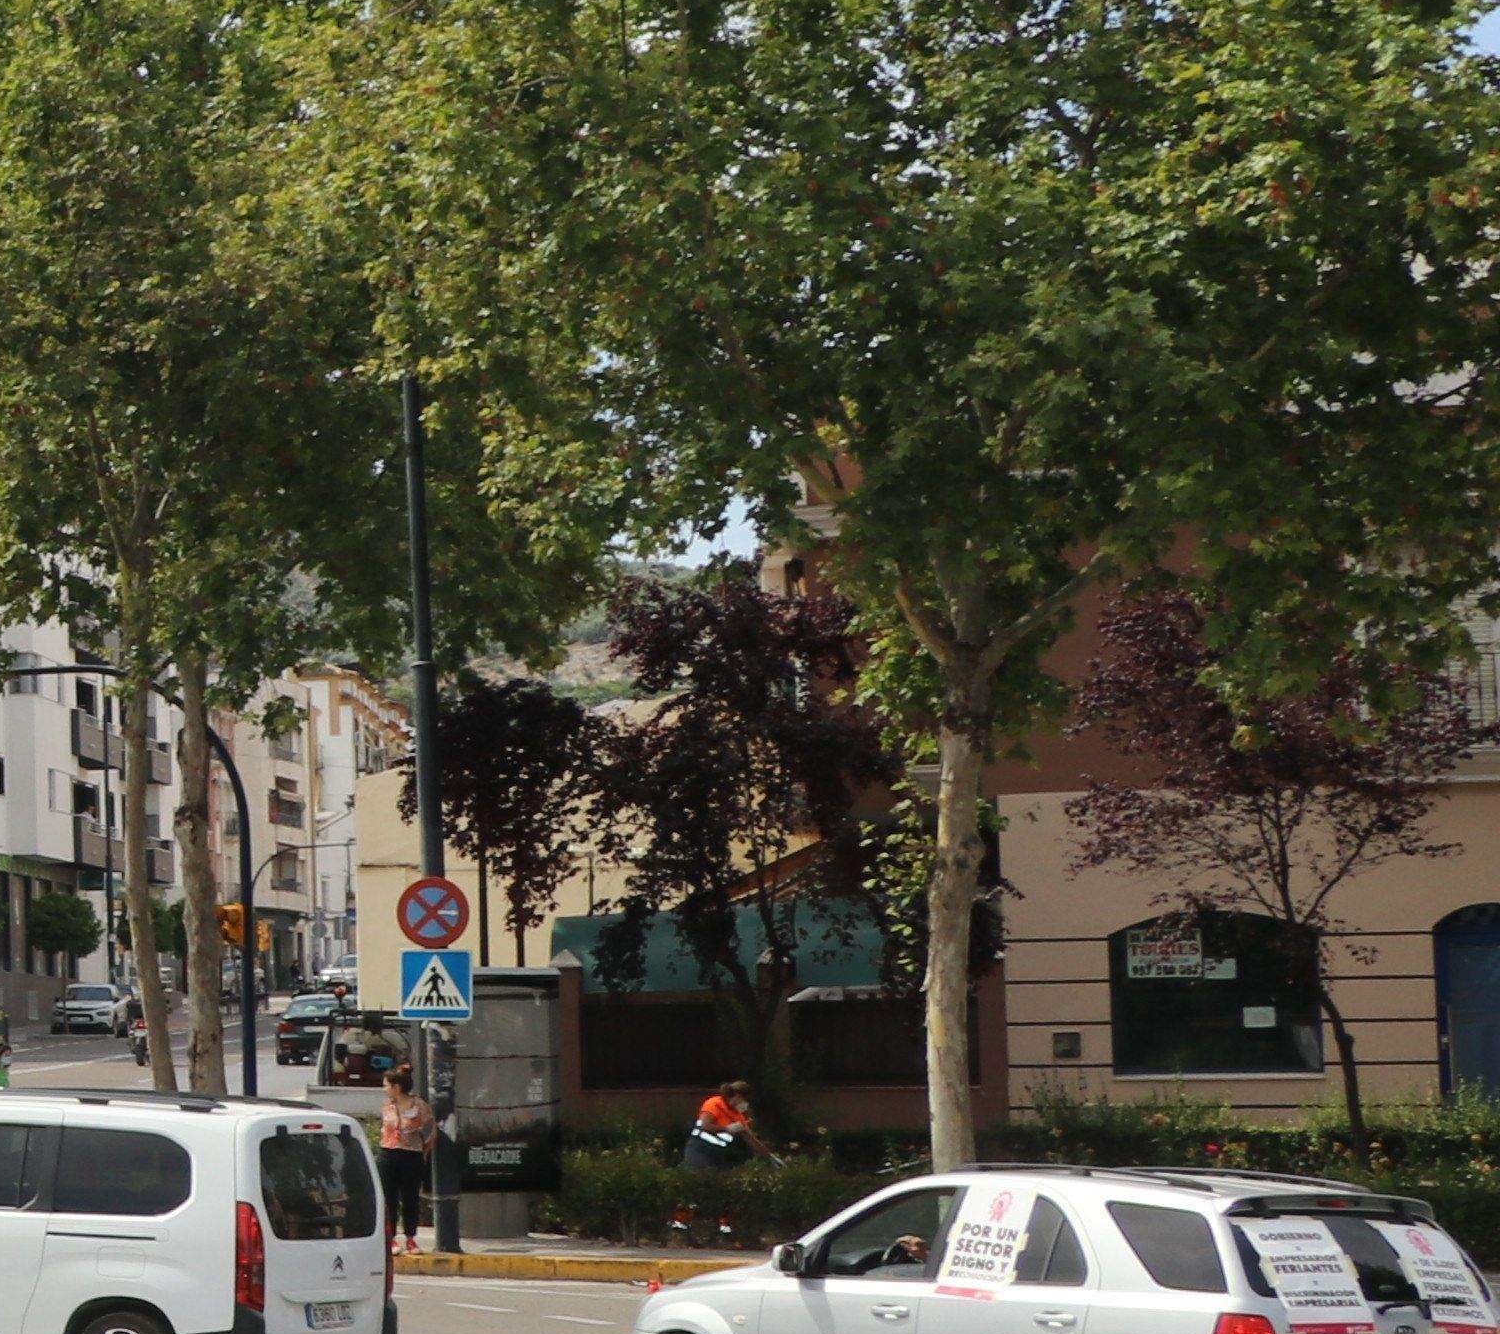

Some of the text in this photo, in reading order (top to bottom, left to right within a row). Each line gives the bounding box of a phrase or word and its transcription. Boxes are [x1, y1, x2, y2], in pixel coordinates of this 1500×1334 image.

[961, 1223, 1021, 1242] POR UN
[1259, 1232, 1322, 1242] GOBIERNO
[955, 1237, 1014, 1259] SECTOR
[951, 1254, 1010, 1273] DIGNO Y
[1269, 1254, 1338, 1263] EMPRESARIOS
[1274, 1263, 1344, 1274] FERIANTES
